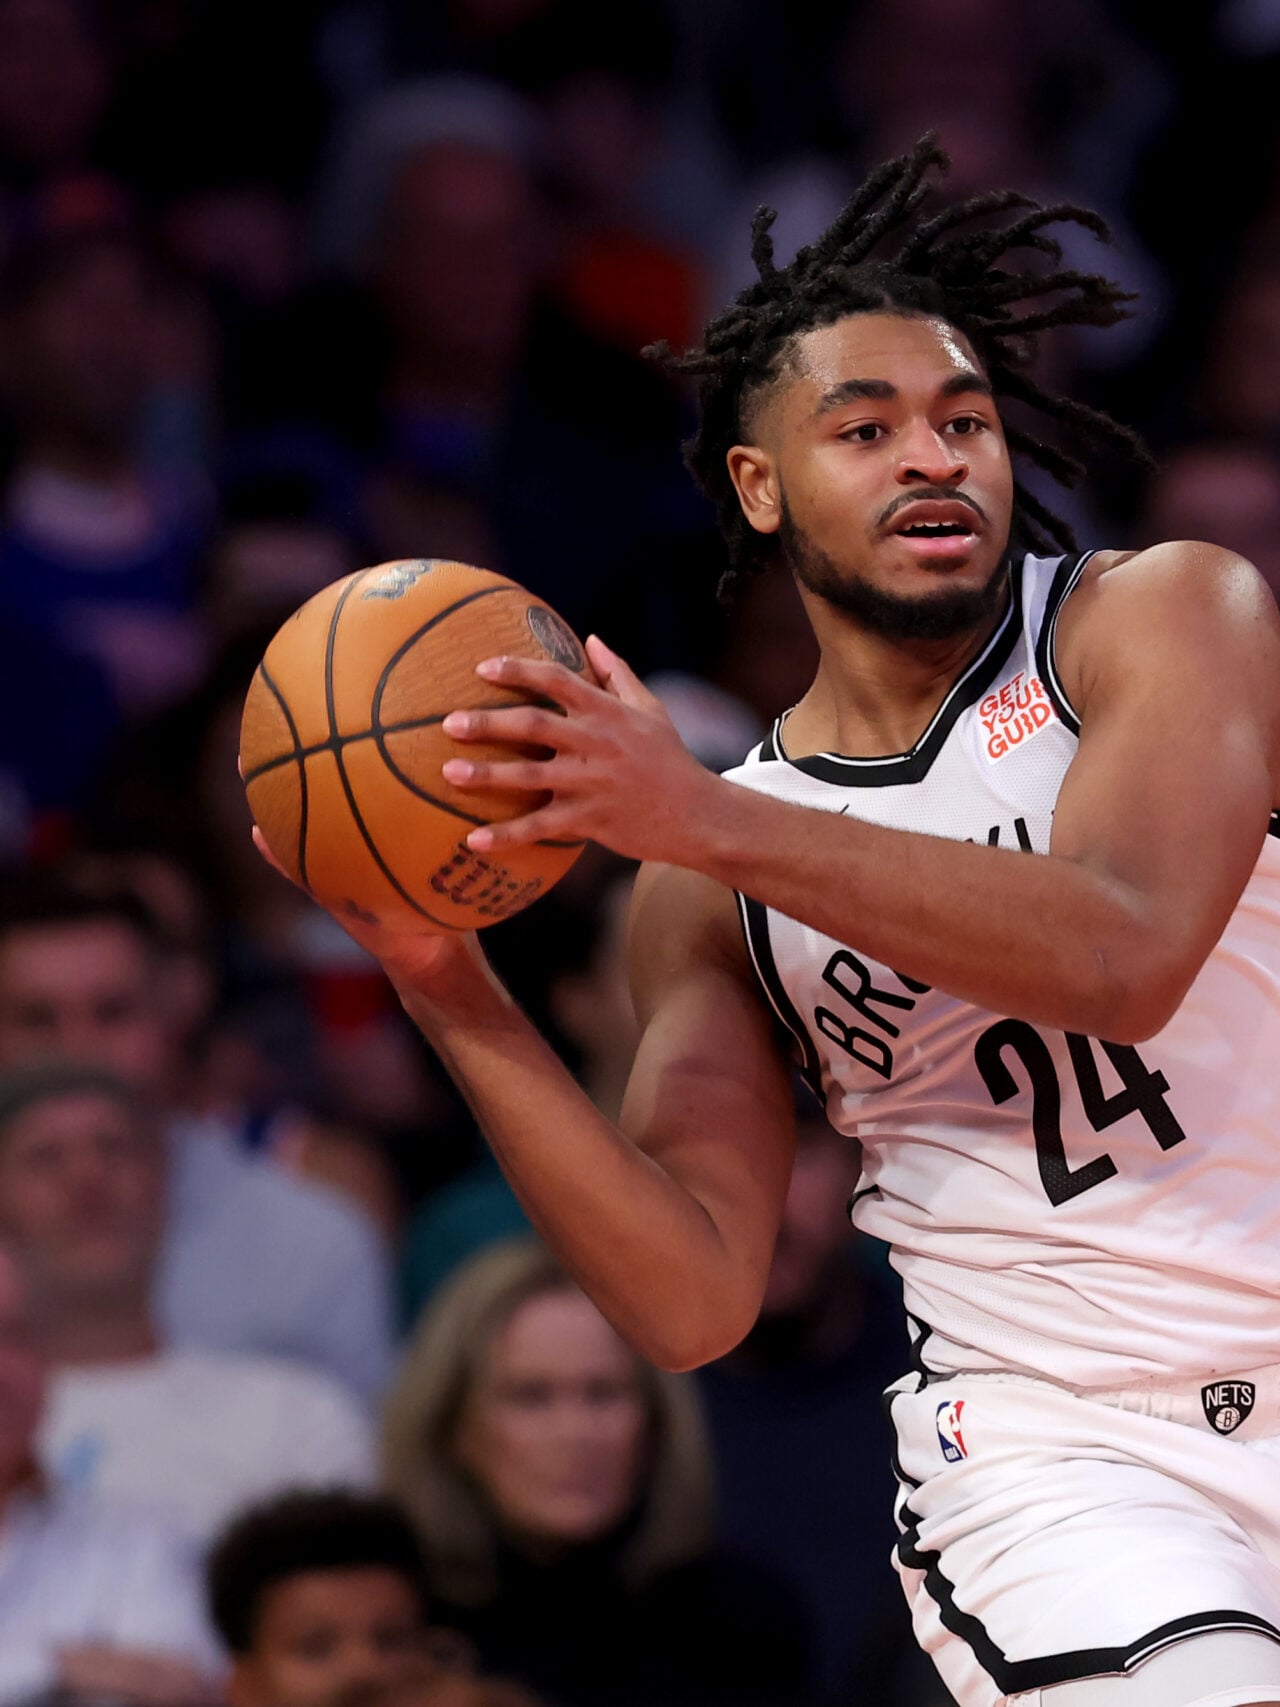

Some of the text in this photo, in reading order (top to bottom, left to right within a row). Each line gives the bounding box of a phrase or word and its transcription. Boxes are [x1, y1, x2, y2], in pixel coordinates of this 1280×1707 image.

[980, 672, 1024, 717] GET
[974, 1018, 1186, 1208] 24
[1206, 1384, 1252, 1409] NETS
